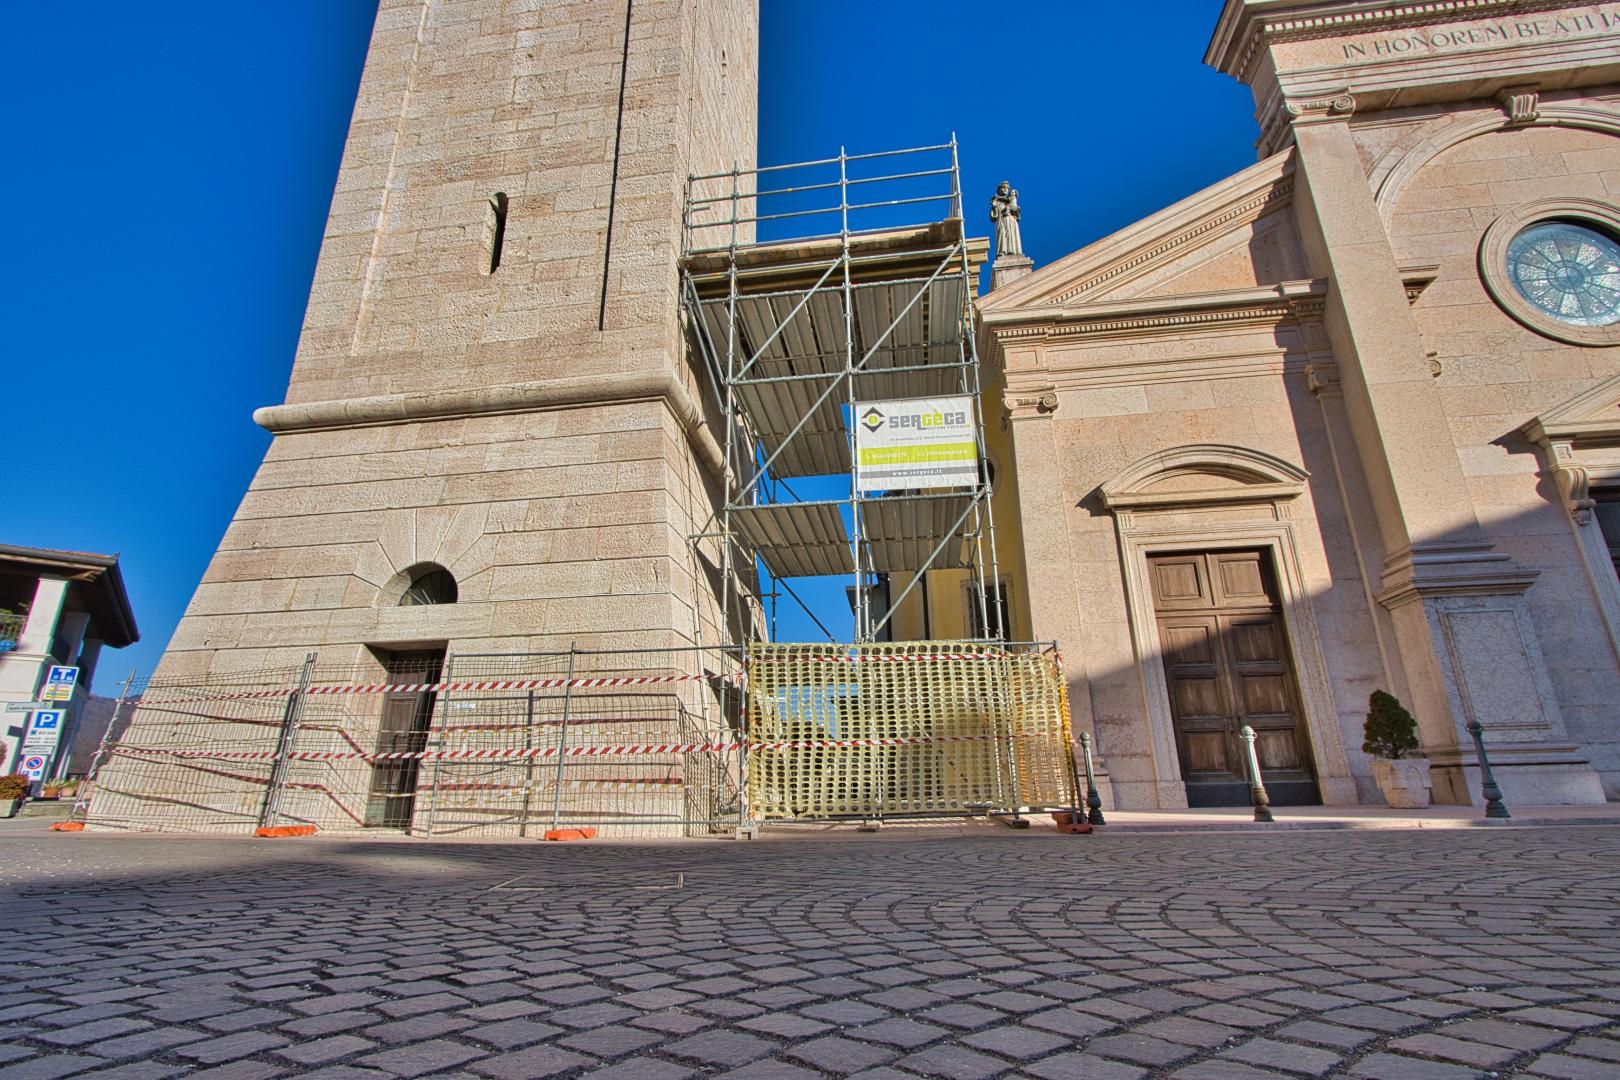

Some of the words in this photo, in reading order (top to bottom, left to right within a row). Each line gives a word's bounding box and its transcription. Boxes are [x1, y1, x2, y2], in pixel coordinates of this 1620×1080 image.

[1342, 41, 1366, 59] IN
[1374, 25, 1509, 56] HONOREM
[1516, 15, 1594, 38] BEATI
[40, 714, 53, 726] P
